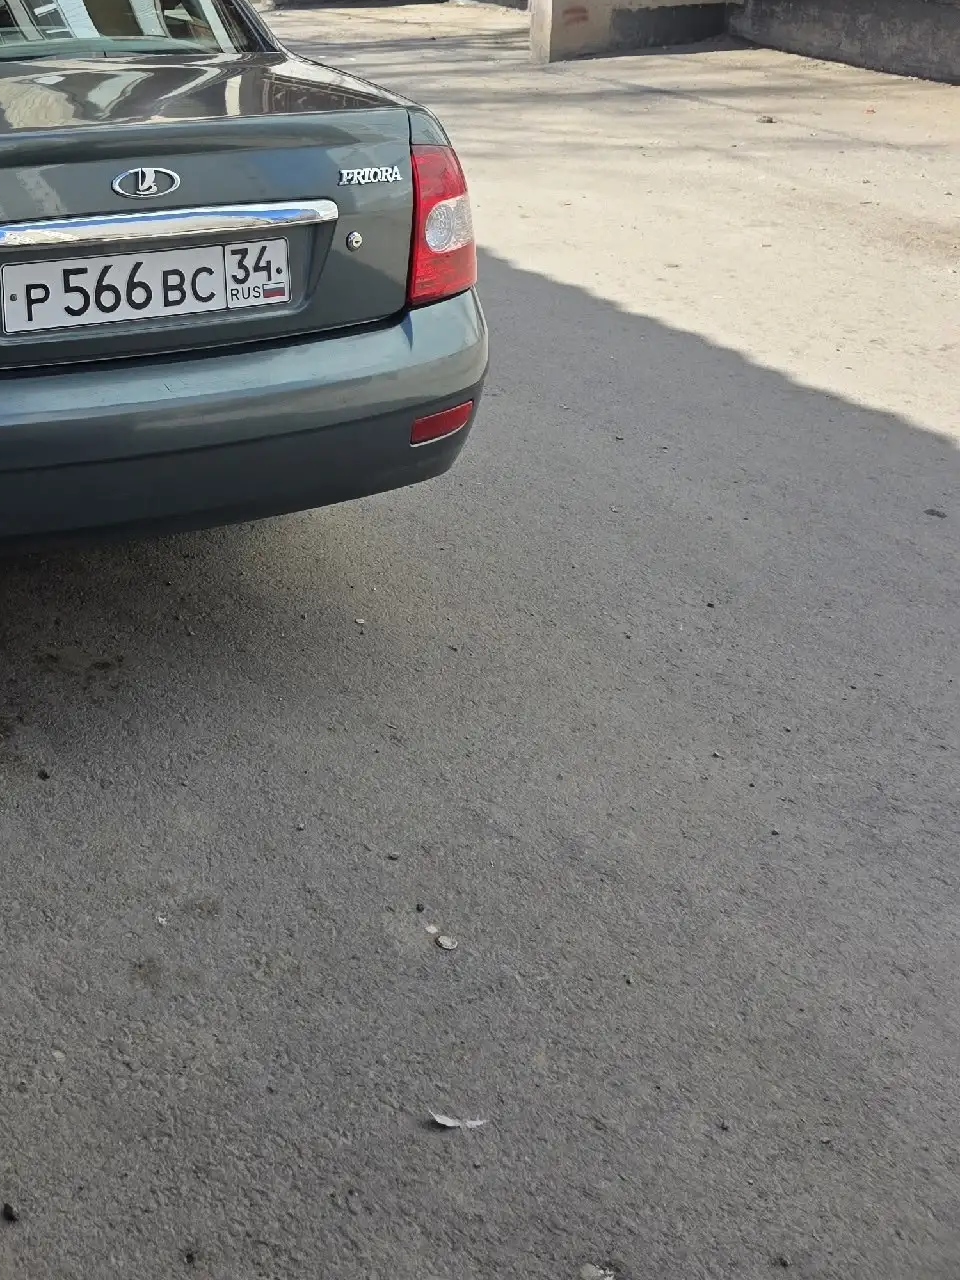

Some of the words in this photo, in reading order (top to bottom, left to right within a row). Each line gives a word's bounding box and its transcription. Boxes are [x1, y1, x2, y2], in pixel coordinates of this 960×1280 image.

[338, 166, 403, 186] PRIORA
[230, 245, 273, 285] 34
[230, 286, 262, 302] RUS
